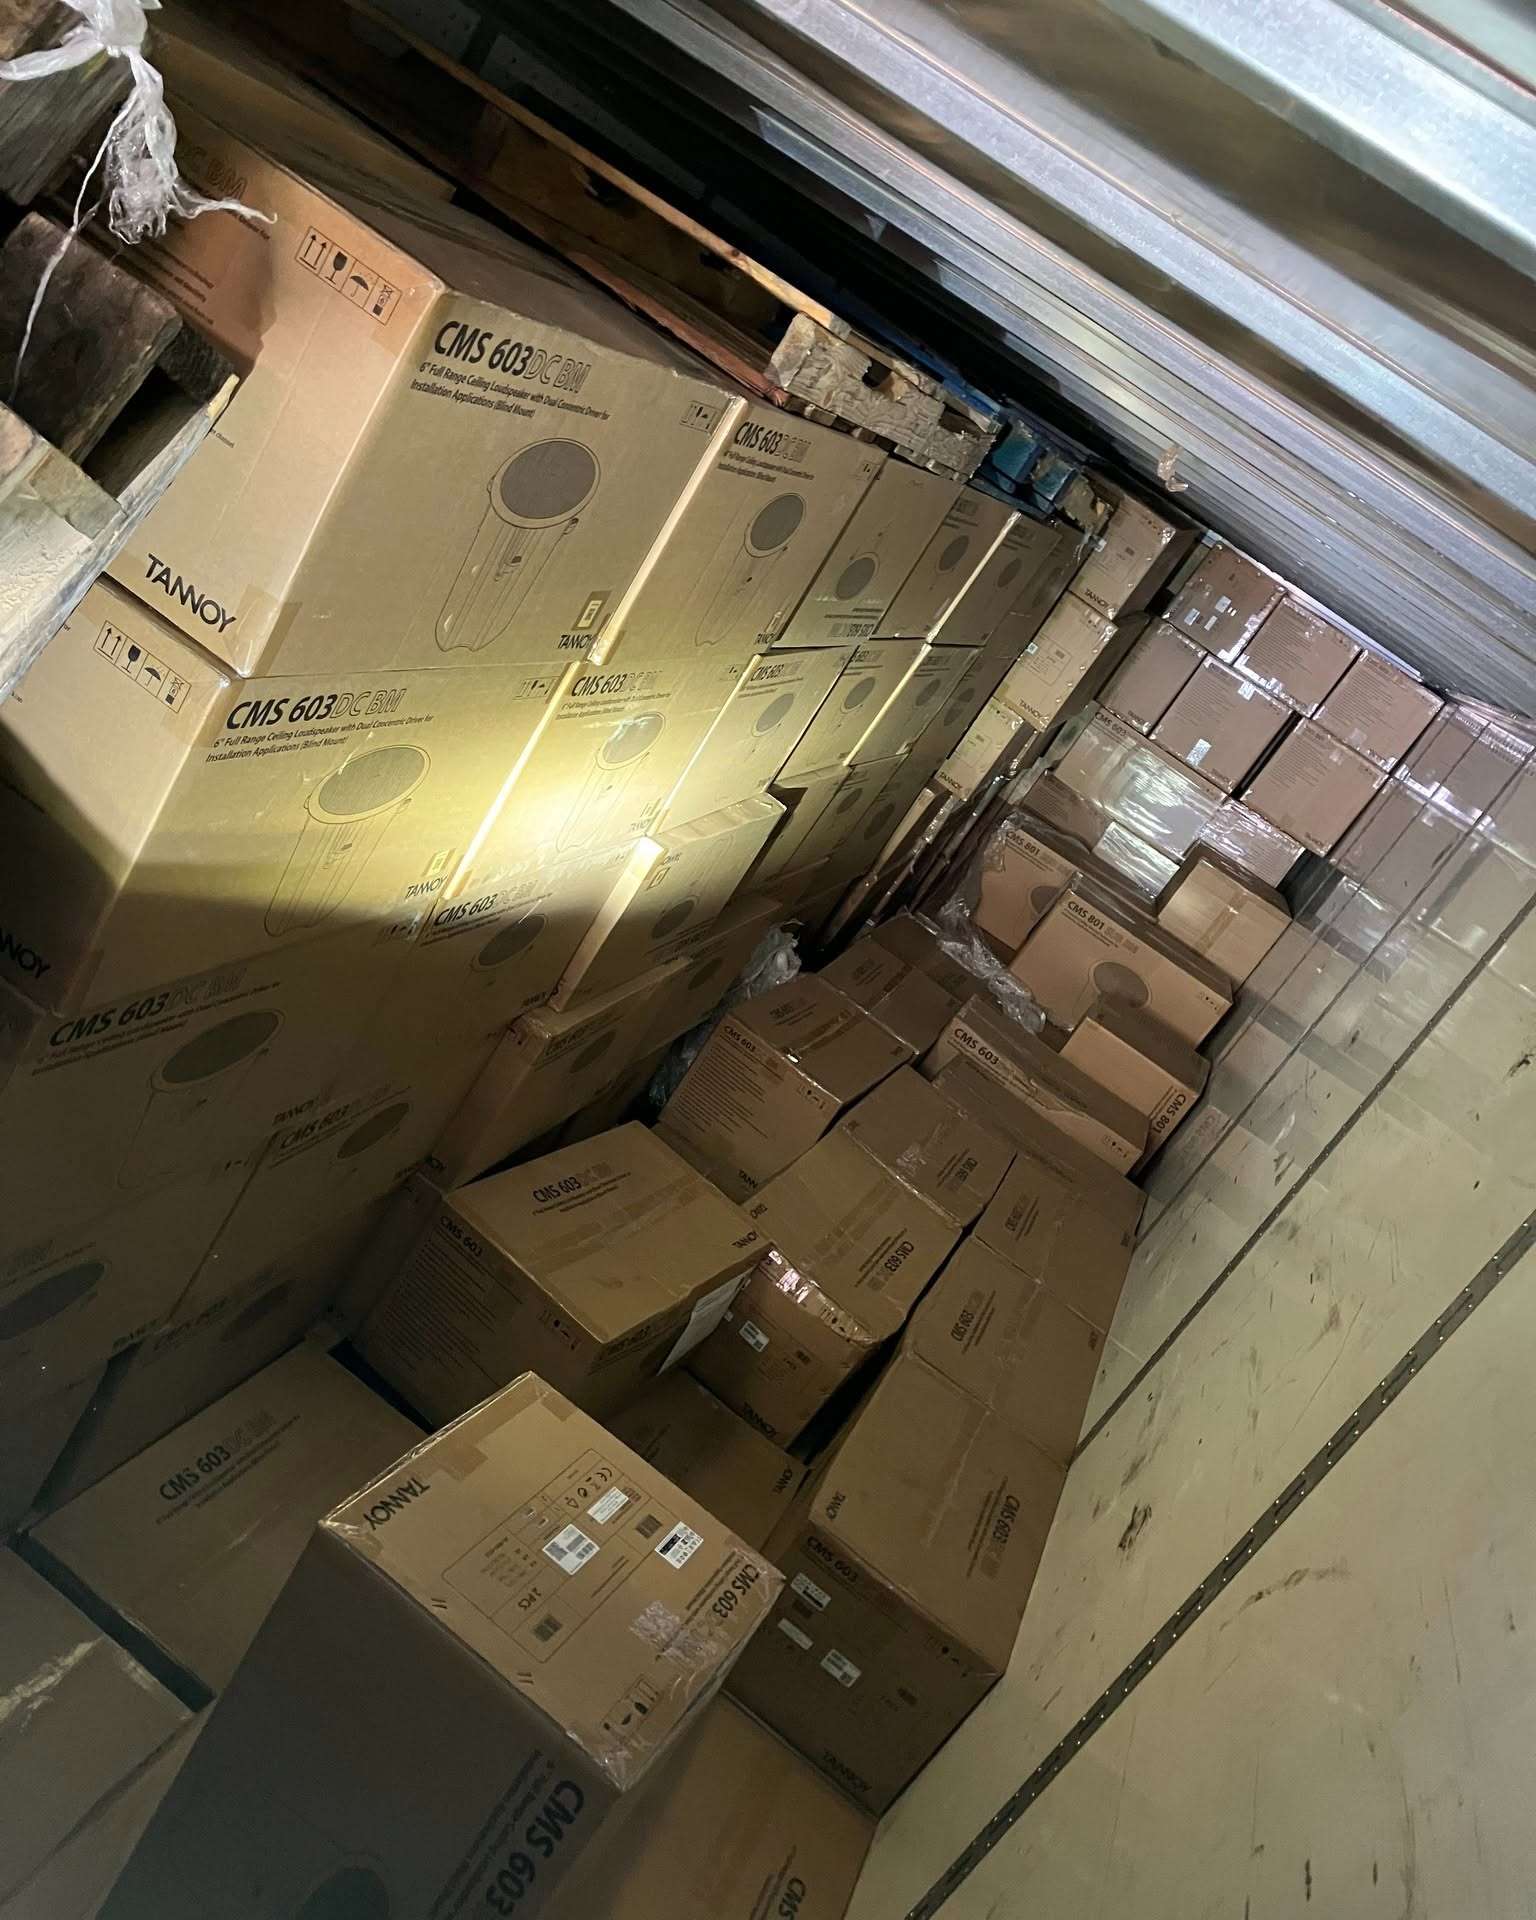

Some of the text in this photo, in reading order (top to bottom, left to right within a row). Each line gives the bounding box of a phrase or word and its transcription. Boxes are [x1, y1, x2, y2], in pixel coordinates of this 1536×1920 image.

[434, 320, 493, 365] CMS
[429, 363, 447, 378] Full
[443, 367, 467, 385] Range
[733, 421, 764, 449] CMS
[145, 552, 237, 633] TANNOY
[571, 676, 604, 697] CMS
[226, 697, 289, 730] CMS
[205, 750, 253, 763] Installation
[252, 743, 300, 757] Applications
[224, 737, 242, 747] Full
[240, 734, 267, 745] Range
[267, 732, 294, 742] Ceiling
[405, 874, 448, 899] TANNOY
[433, 902, 471, 926] CMS
[1067, 900, 1105, 931] CMS 801
[50, 1008, 118, 1047] CMS
[723, 1025, 742, 1042] CMS
[953, 1027, 1000, 1067] CMS 603
[1152, 1093, 1187, 1135] CMS 801
[532, 1176, 582, 1203] CMS 603
[738, 1168, 758, 1189] TANN
[439, 1215, 462, 1240] CMS
[896, 1241, 914, 1260] CMS
[159, 1467, 200, 1501] CMS
[363, 1477, 431, 1531] TANNOY
[1000, 1495, 1021, 1523] CMS
[807, 1536, 833, 1562] CMS
[712, 1564, 760, 1618] CMS 603
[526, 1780, 585, 1858] CMS
[486, 1852, 536, 1916] 603
